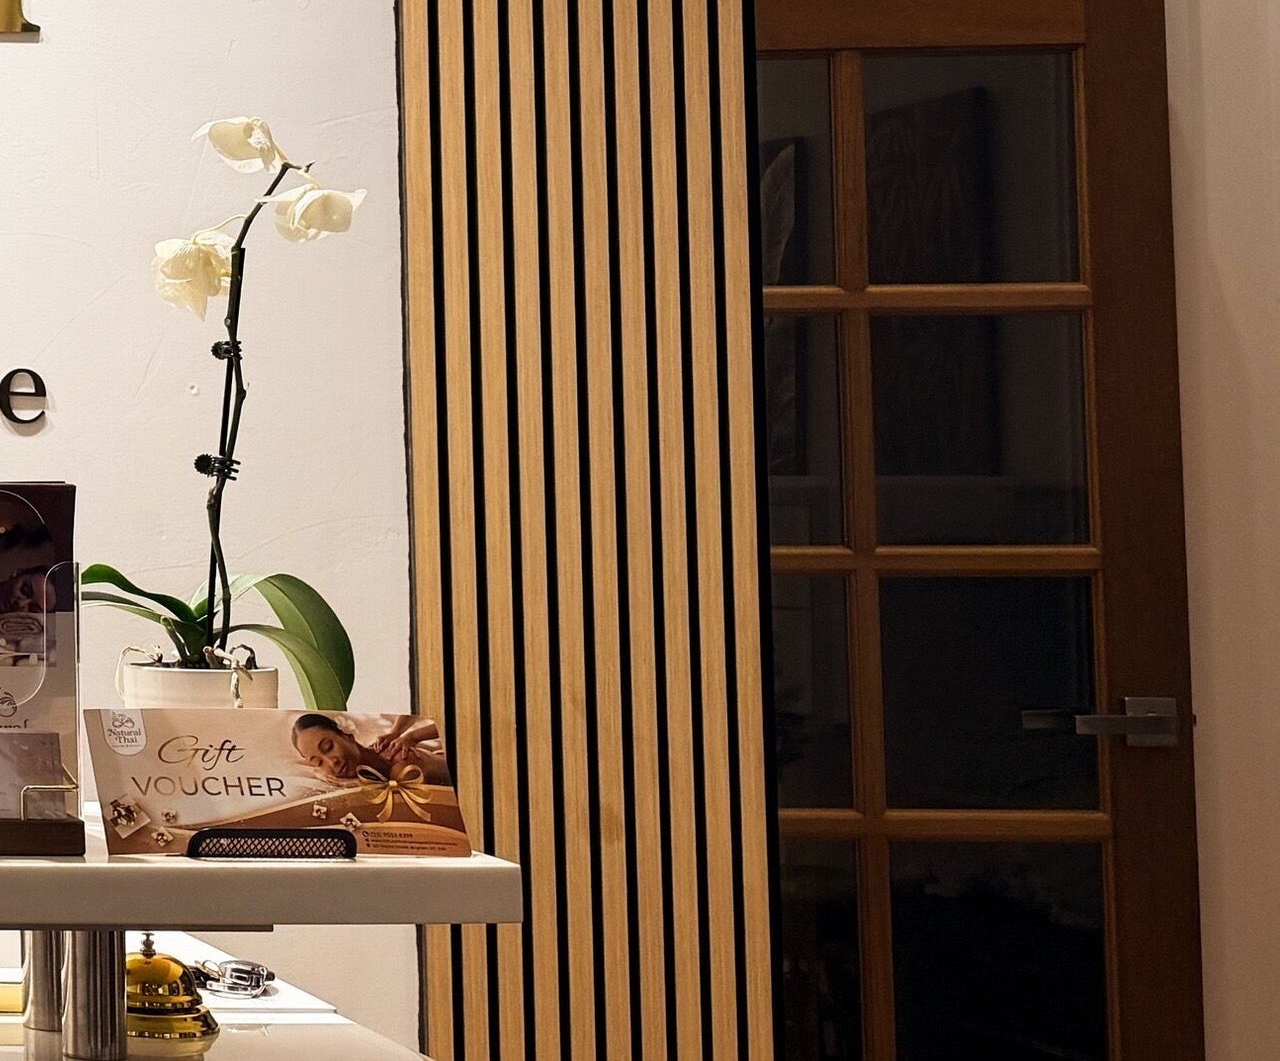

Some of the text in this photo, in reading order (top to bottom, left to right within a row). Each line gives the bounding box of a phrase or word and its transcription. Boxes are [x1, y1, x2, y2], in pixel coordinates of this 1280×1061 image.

[106, 728, 142, 737] Natural
[115, 736, 138, 744] Thai
[157, 734, 245, 771] Gift
[131, 775, 287, 798] VOUCHER
